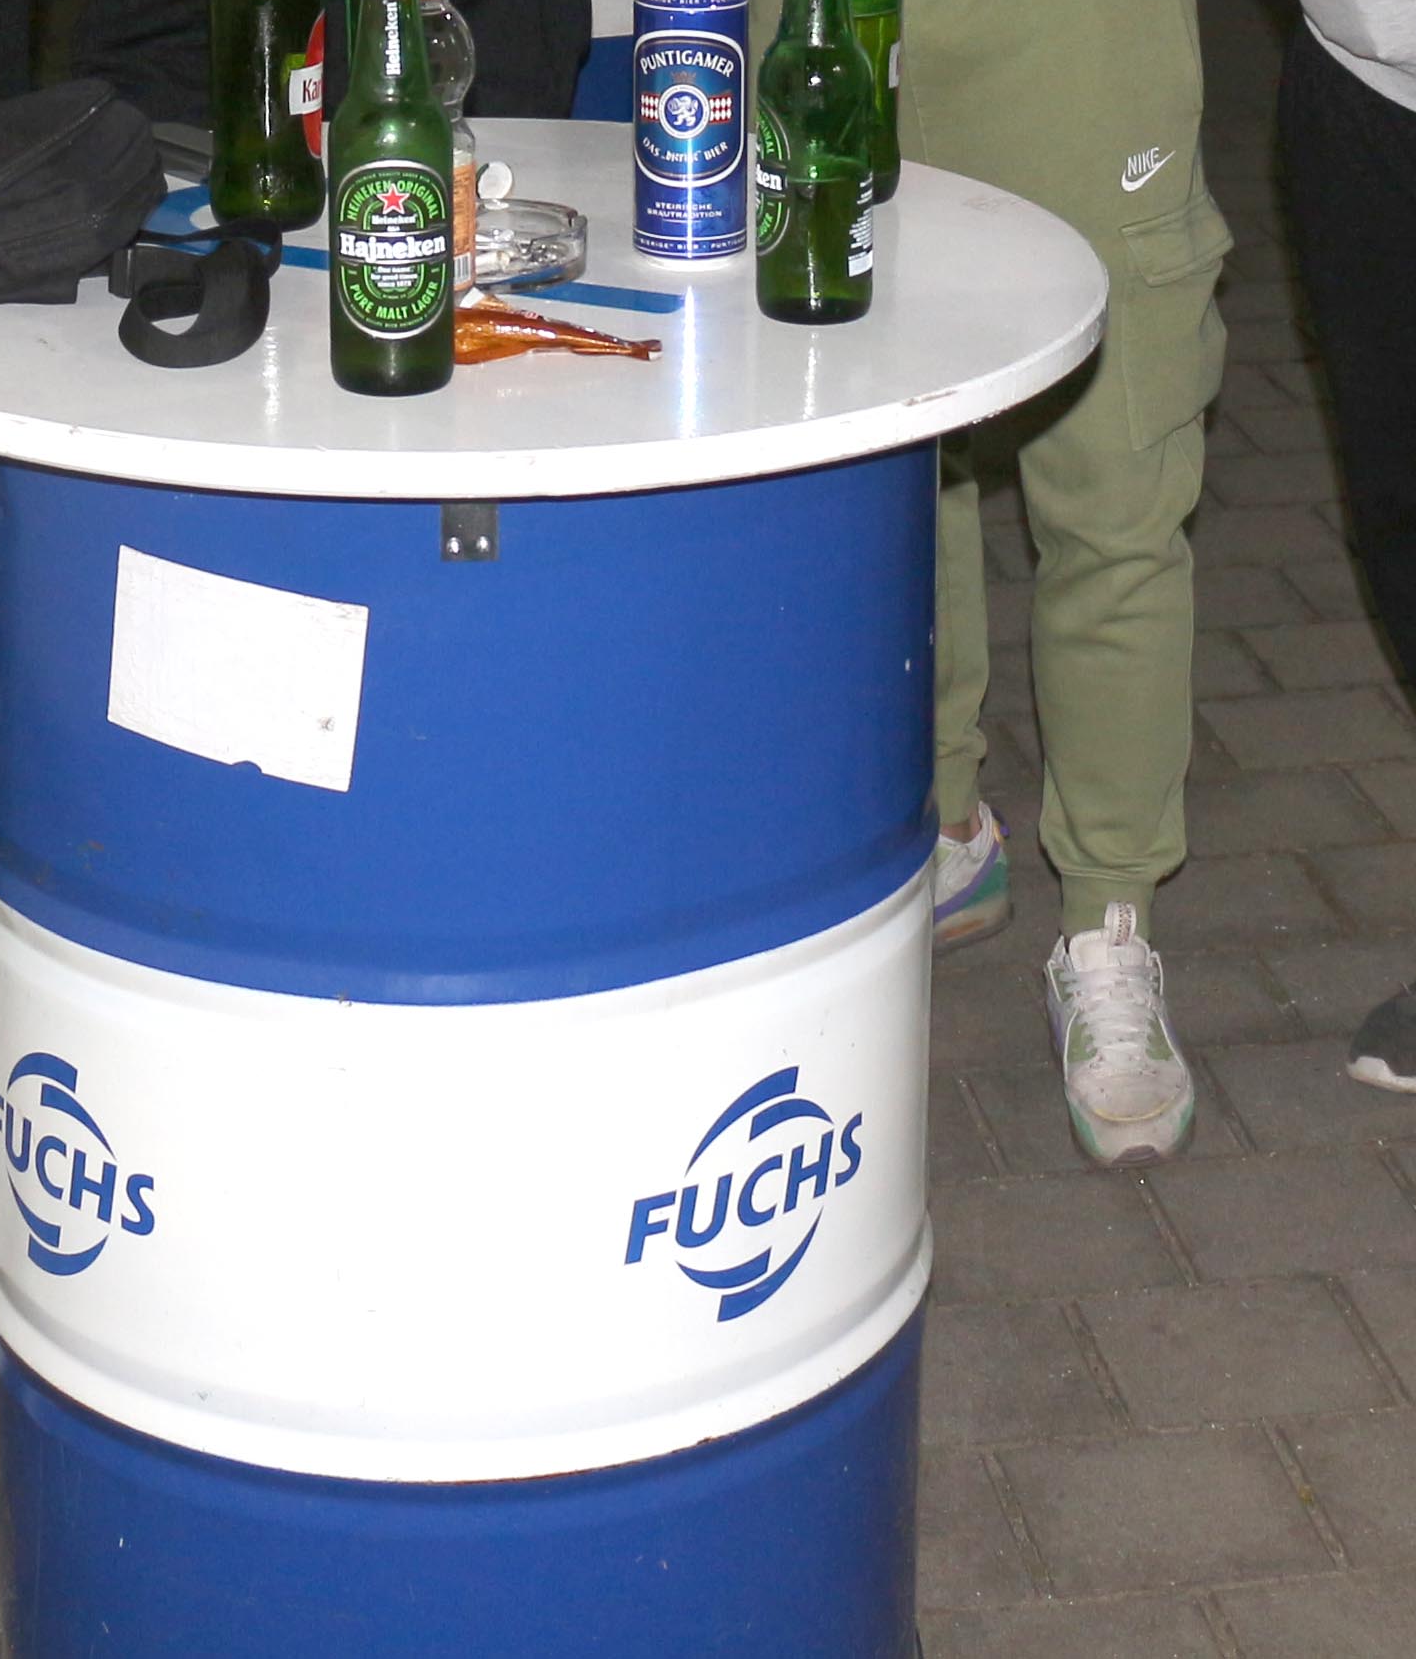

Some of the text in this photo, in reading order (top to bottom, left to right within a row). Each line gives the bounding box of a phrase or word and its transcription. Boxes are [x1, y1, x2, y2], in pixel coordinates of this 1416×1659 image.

[385, 2, 401, 75] Heineken
[640, 50, 734, 77] PUNTIGAMER
[642, 137, 661, 157] DAS
[703, 142, 729, 161] BIER
[1128, 147, 1160, 177] NIKE
[347, 180, 392, 221] HEINEKEN
[397, 180, 439, 219] ORIGINAL
[655, 202, 712, 210] STEIRICHE
[340, 233, 446, 262] Hajneken
[350, 284, 374, 313] PURE
[376, 306, 408, 319] MALT
[411, 282, 438, 314] LAGER
[624, 1111, 863, 1266] FUCHS
